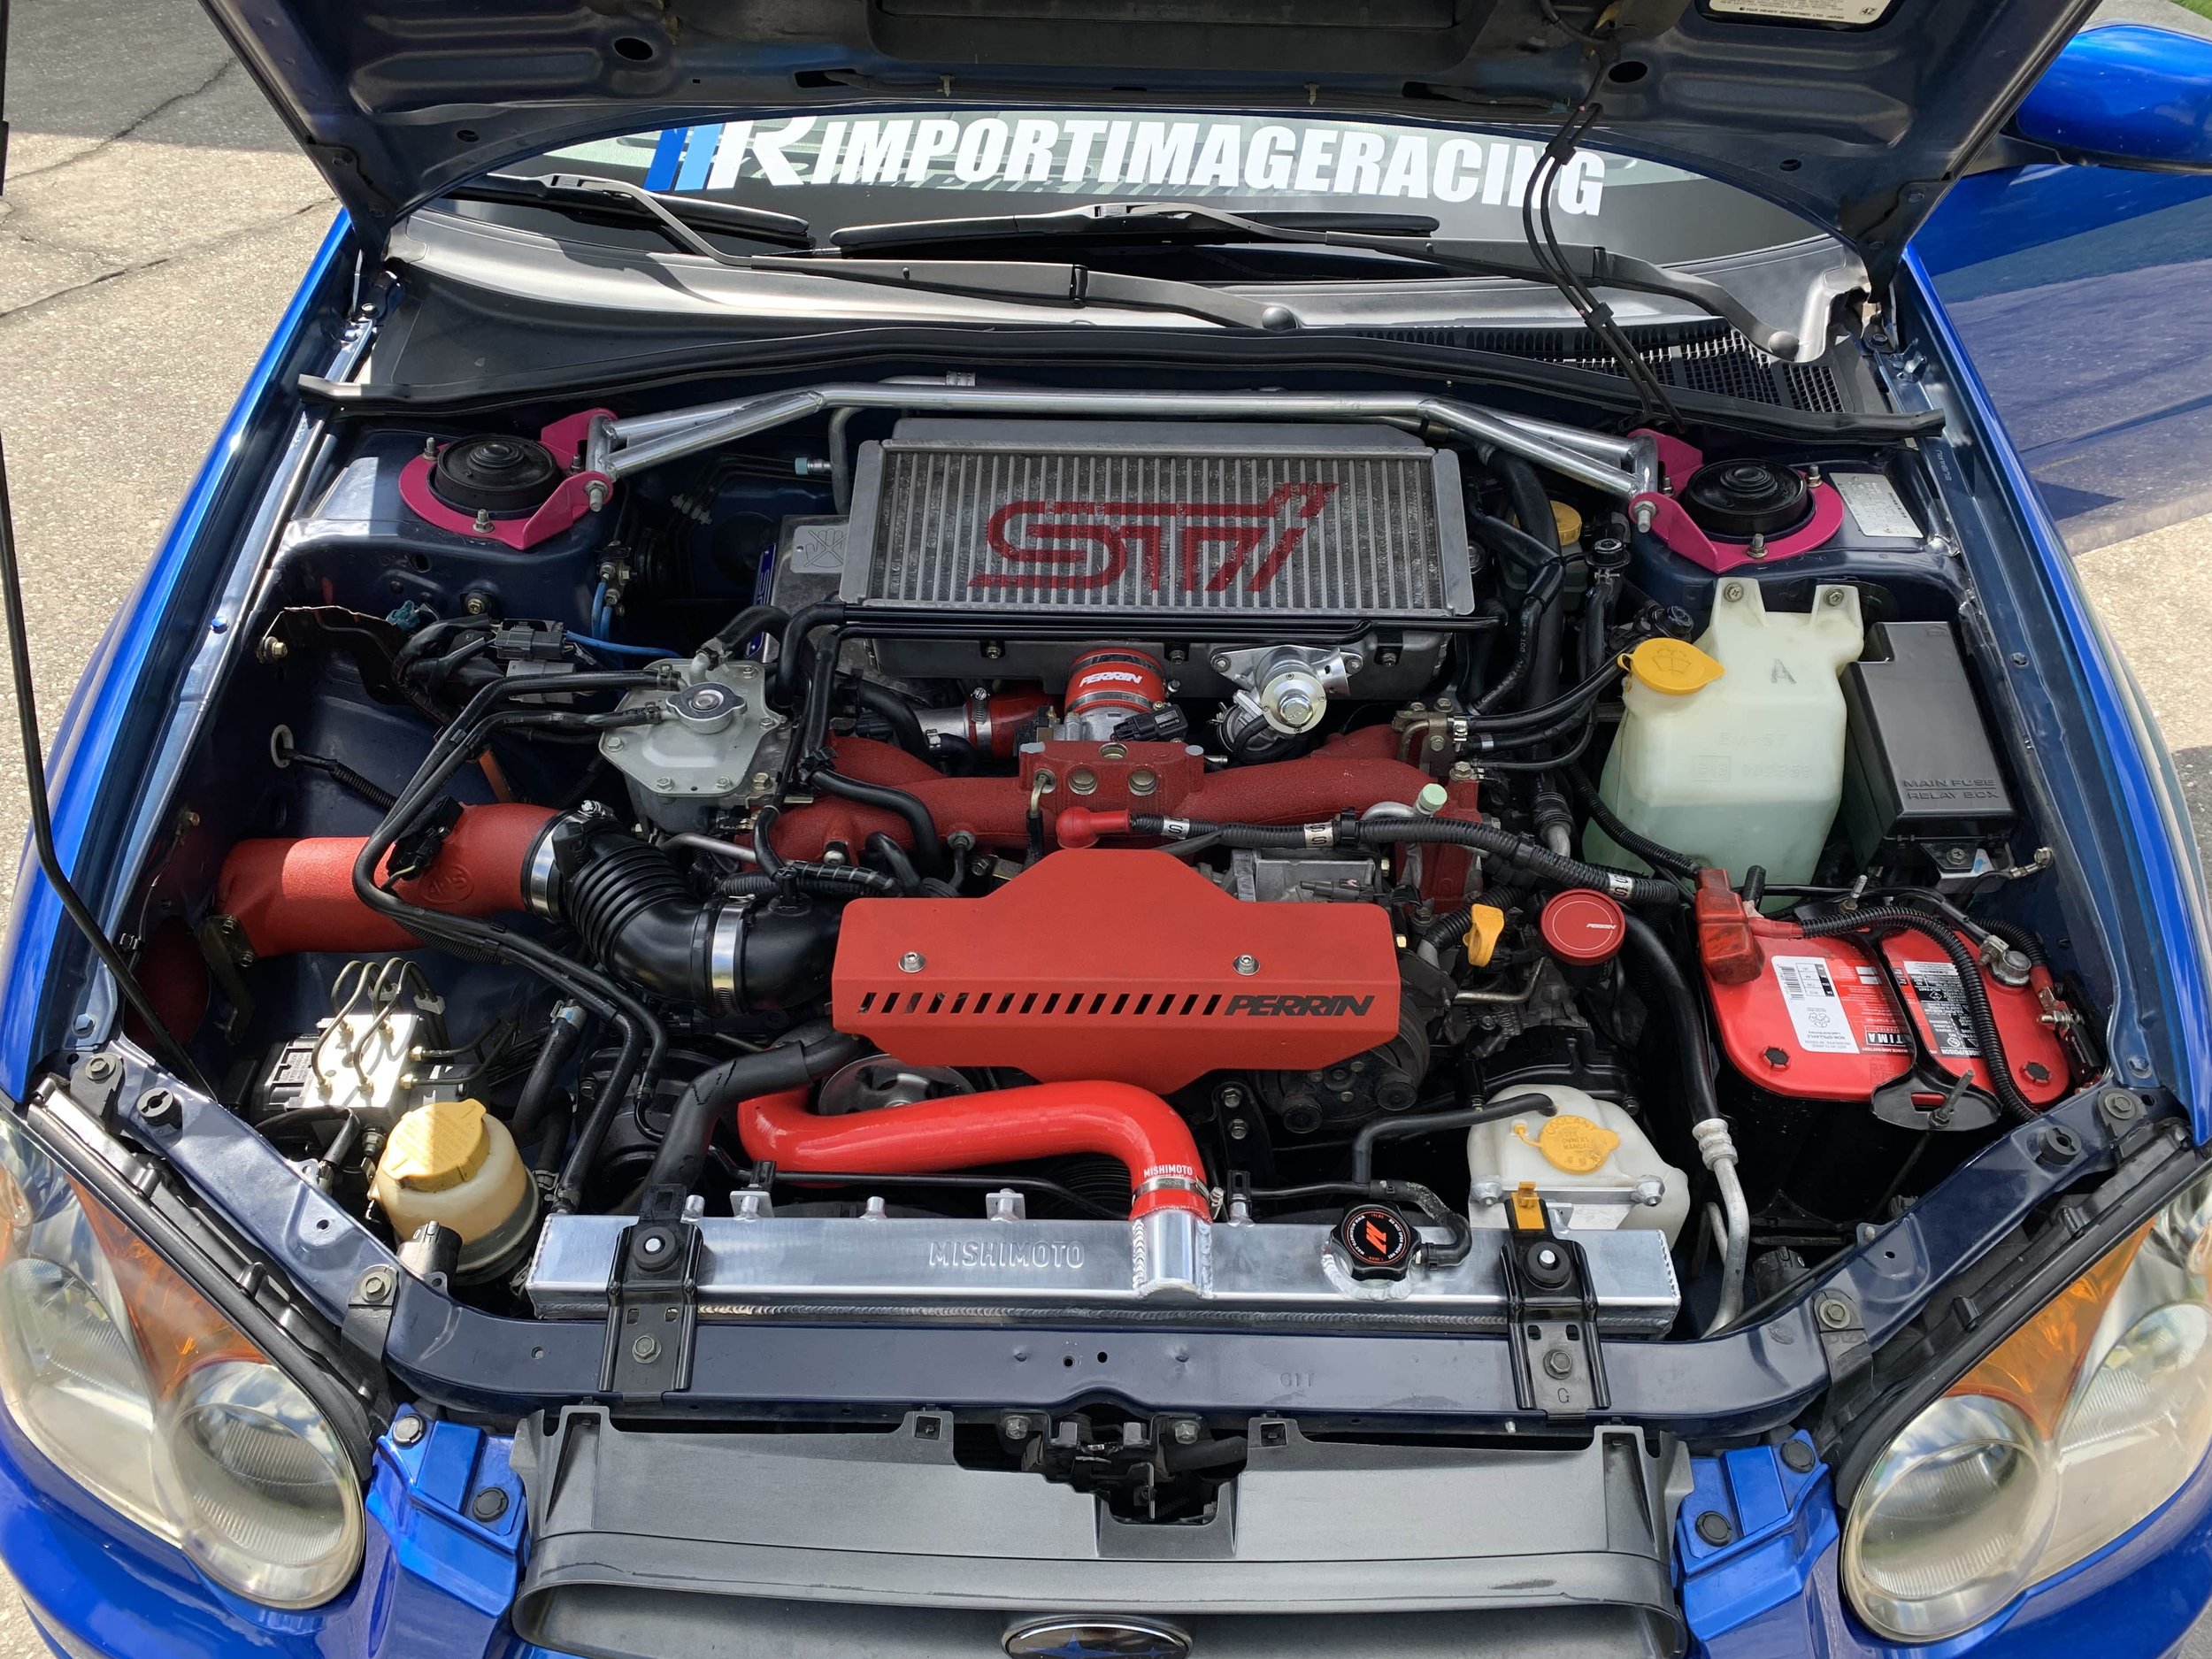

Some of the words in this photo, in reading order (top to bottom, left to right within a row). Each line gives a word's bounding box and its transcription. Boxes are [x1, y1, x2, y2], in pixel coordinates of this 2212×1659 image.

[1935, 449, 1953, 481] SUBARU
[1078, 671, 1143, 688] PERRIN
[1903, 779, 1947, 787] MAIN
[1907, 791, 1958, 800] RELAY
[1963, 790, 2000, 799] BOX
[1224, 995, 1376, 1017] PERRIN
[1868, 1032, 1904, 1044] TIMA
[1545, 1117, 1601, 1135] COOLANT
[1142, 1164, 1194, 1179] MISHIMOTO
[928, 1240, 1086, 1270] MISHIMOTO
[1557, 1387, 1571, 1404] G
